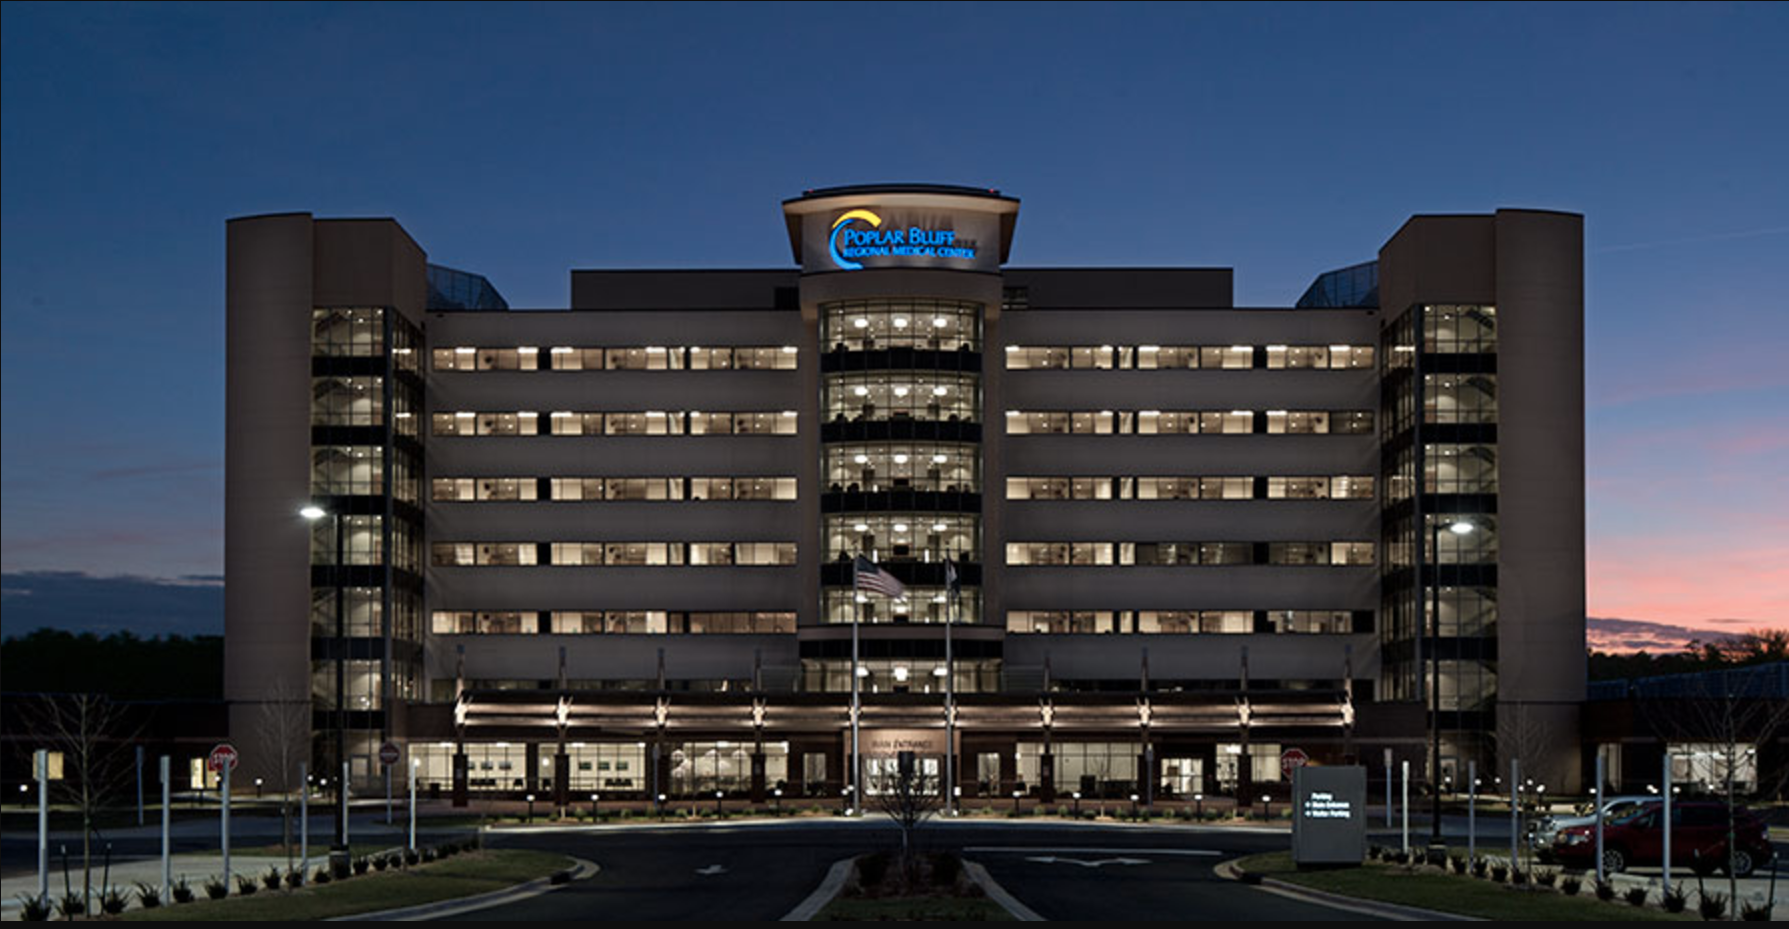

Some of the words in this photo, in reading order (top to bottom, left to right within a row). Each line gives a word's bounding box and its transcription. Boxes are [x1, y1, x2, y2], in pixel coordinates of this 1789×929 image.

[844, 228, 905, 246] POPLAR
[908, 227, 955, 246] BLUFF
[842, 246, 889, 258] REGIONAL
[892, 246, 936, 256] MEDICAL
[937, 247, 976, 259] CENTER
